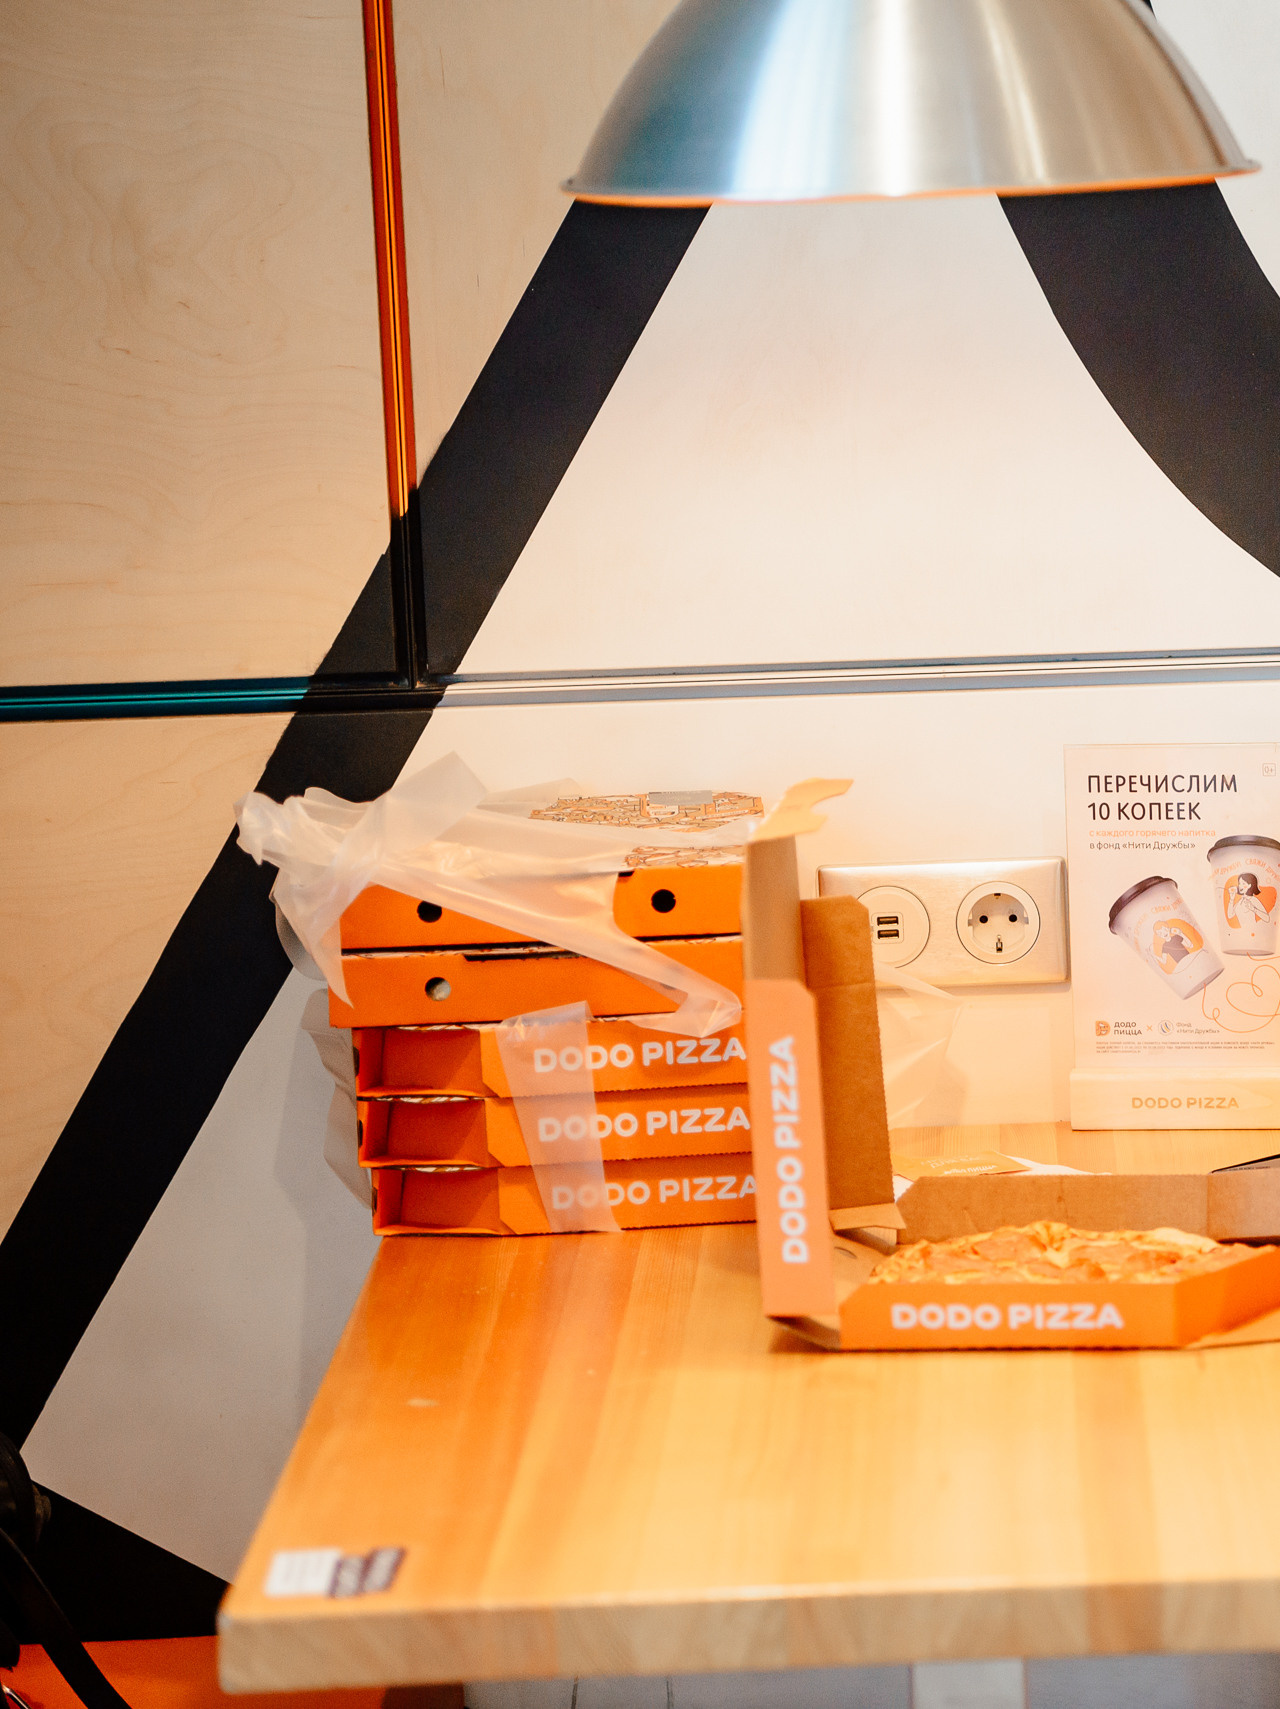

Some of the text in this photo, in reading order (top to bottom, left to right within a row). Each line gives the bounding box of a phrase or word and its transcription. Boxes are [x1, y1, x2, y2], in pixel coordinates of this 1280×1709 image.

[1087, 774, 1238, 793] ПЕРЕЧИСЛИМ
[1087, 802, 1201, 821] 10 КОПЕЕК
[1096, 830, 1134, 838] каждого
[1136, 830, 1177, 839] горячего
[1179, 829, 1216, 837] напитка
[1096, 841, 1121, 850] фонд
[1122, 841, 1152, 850] «Нити
[1152, 841, 1196, 851] Дружбы»
[534, 1037, 746, 1073] DODO PIZZA
[1131, 1097, 1240, 1109] DODO PIZZA
[538, 1106, 750, 1142] DODO PIZZA
[769, 1035, 809, 1263] DODO PIZZA
[552, 1174, 757, 1209] DODO PIZZA
[891, 1303, 1124, 1330] DODO PIZZA
